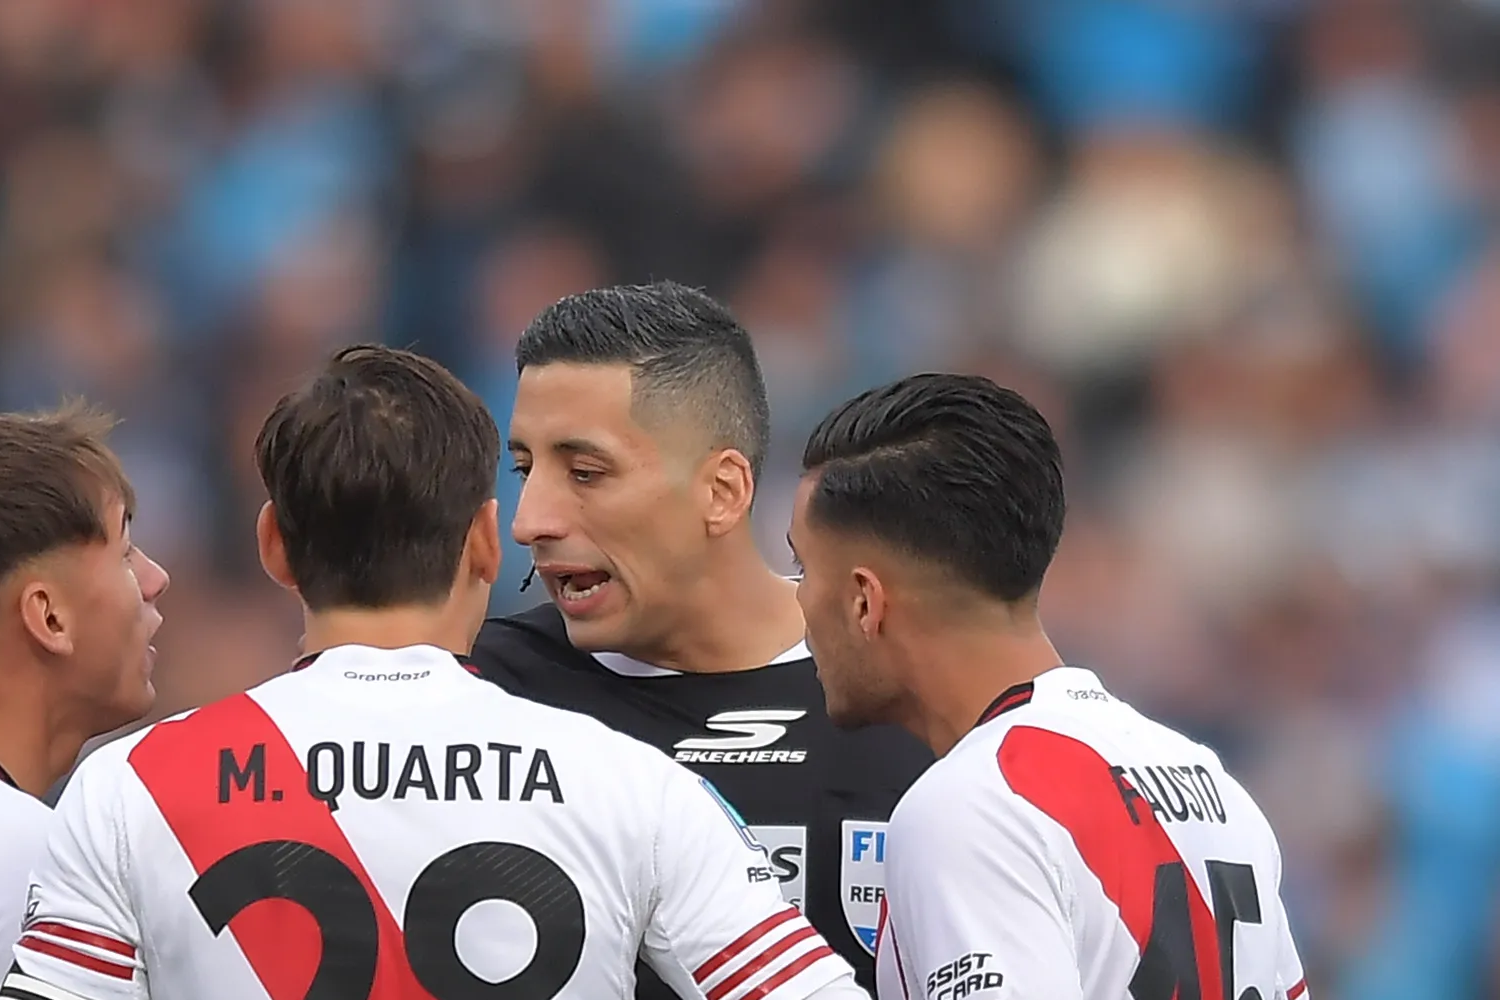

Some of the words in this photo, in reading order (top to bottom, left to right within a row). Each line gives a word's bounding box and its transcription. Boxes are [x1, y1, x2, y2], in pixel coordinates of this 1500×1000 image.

[218, 744, 284, 804] M.
[306, 741, 565, 813] QUARTA
[674, 750, 807, 763] SKECHERS
[1108, 764, 1227, 825] FAUSTO
[852, 831, 885, 862] FI
